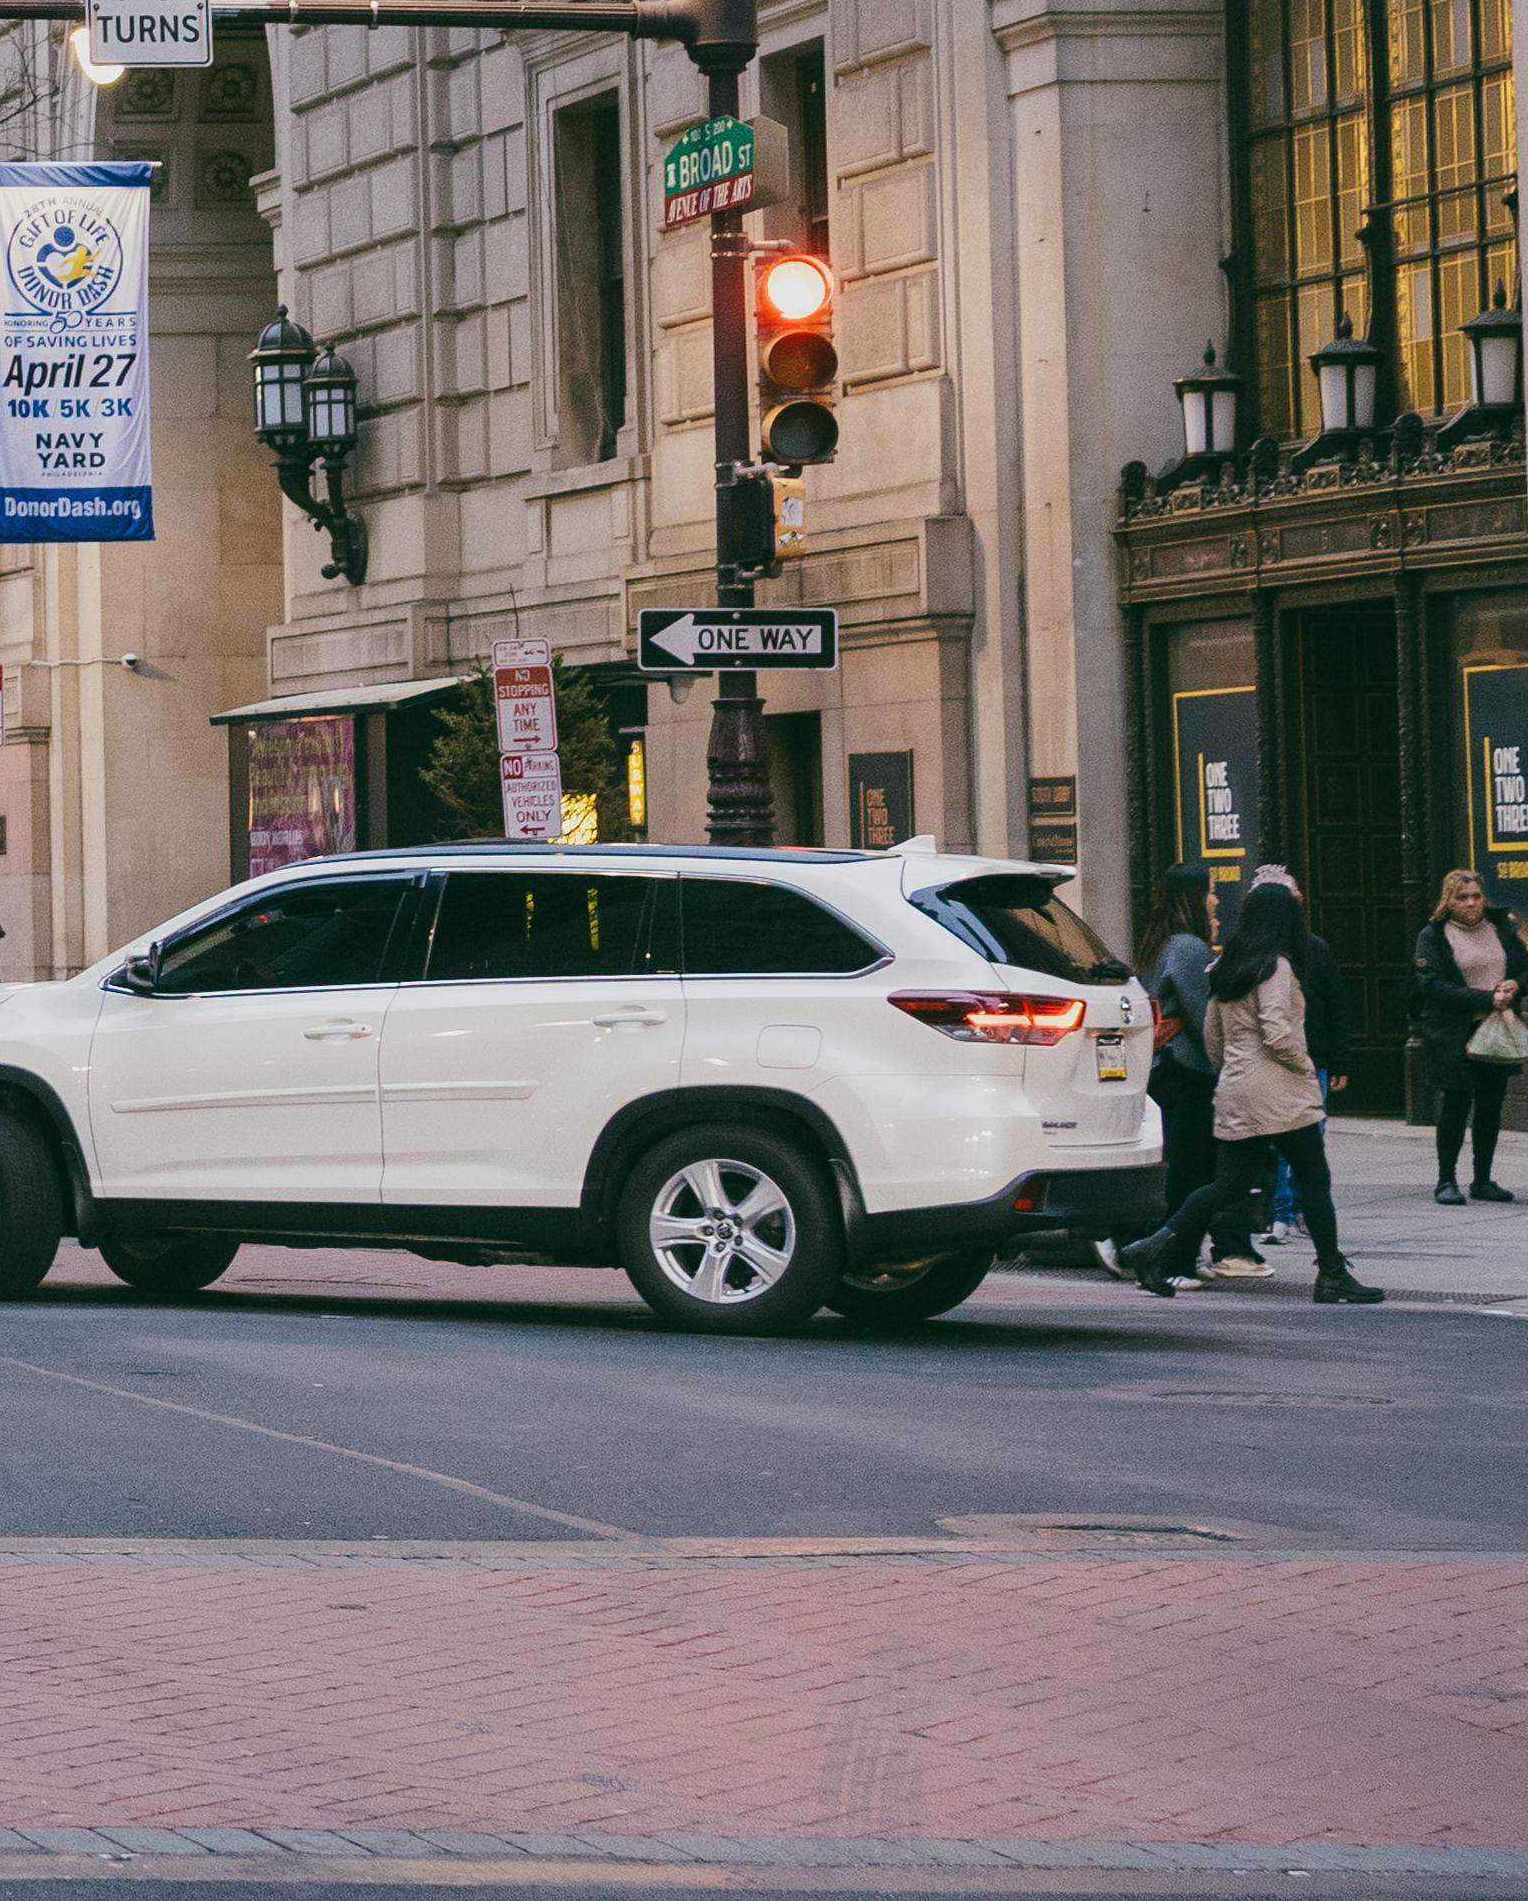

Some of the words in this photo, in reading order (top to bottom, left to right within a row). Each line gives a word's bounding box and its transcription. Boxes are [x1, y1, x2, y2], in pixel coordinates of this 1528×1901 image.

[97, 15, 200, 43] TURNS
[680, 141, 733, 189] BROAD
[738, 143, 752, 169] ST
[24, 198, 56, 217] 28TH
[667, 192, 698, 223] AVENUE
[699, 189, 711, 212] OF
[712, 182, 730, 209] THE
[730, 175, 753, 203] ARTS
[20, 212, 51, 248] GIFT
[54, 209, 77, 224] OF
[79, 213, 110, 246] LIFE
[18, 265, 72, 309] DONOR
[77, 265, 114, 307] DASH
[50, 310, 83, 334] 50
[85, 316, 137, 327] YEARS
[5, 336, 22, 348] OF
[26, 335, 87, 348] SAVING
[92, 334, 137, 347] LIVES
[2, 354, 86, 397] April
[89, 353, 137, 388] 27
[8, 399, 50, 418] 10K
[60, 399, 90, 418] 5K
[101, 398, 133, 417] 3K
[36, 432, 104, 450] NAVY
[37, 452, 106, 469] YARD
[4, 496, 142, 519] DonorDash.org
[698, 628, 749, 650] ONE
[760, 628, 813, 650] WAY
[498, 683, 549, 698] STOPPING
[514, 703, 537, 716] ANY
[513, 718, 540, 732] TIME
[505, 759, 520, 776] NO
[1493, 747, 1520, 775] ONE
[1206, 762, 1228, 787] ONE
[868, 788, 885, 805] ONE
[1207, 788, 1232, 813] TWO
[1495, 776, 1525, 803] TWO
[516, 810, 551, 823] ONLY
[868, 807, 888, 825] TWO
[1208, 814, 1240, 840] THREE
[869, 827, 894, 844] THREE
